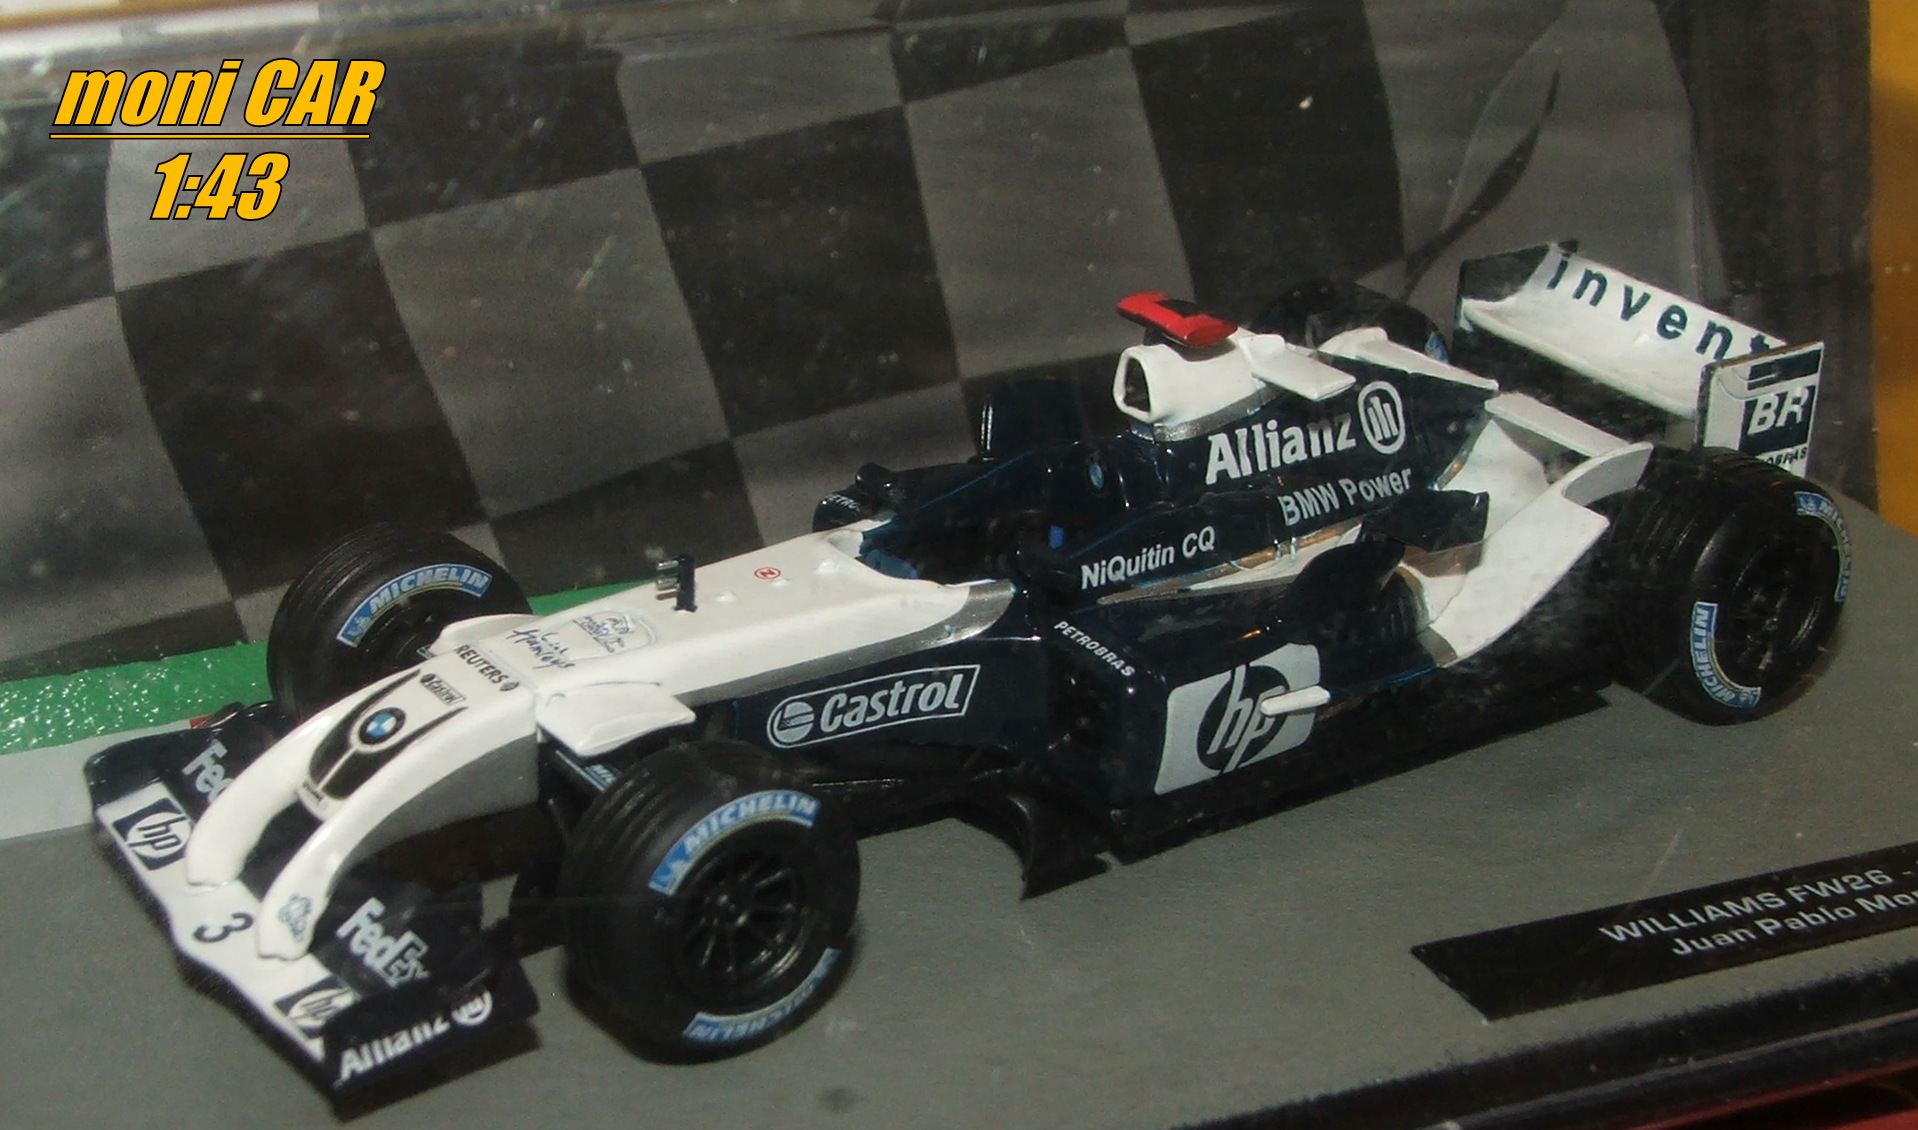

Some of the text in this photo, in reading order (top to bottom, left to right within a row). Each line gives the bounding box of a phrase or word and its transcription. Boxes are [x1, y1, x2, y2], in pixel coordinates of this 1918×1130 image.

[1747, 385, 1809, 436] BR
[1204, 411, 1357, 485] Allianz
[1278, 467, 1412, 527] BMW Power
[1080, 525, 1216, 590] NiQuitin CQ
[369, 567, 489, 614] MICHELIN
[455, 643, 510, 685] REUTERS
[1053, 620, 1136, 677] PETROBRAS
[1693, 605, 1737, 703] MICHELIN
[820, 673, 964, 733] Castrol
[1205, 663, 1288, 774] hp
[127, 815, 188, 850] hp
[685, 791, 819, 856] MICHELIN
[193, 912, 255, 943] 3
[1600, 891, 1788, 943] WILLIAMS
[1785, 868, 1893, 903] FW26
[1671, 925, 1758, 957] Juan
[1759, 905, 1857, 936] Pablo
